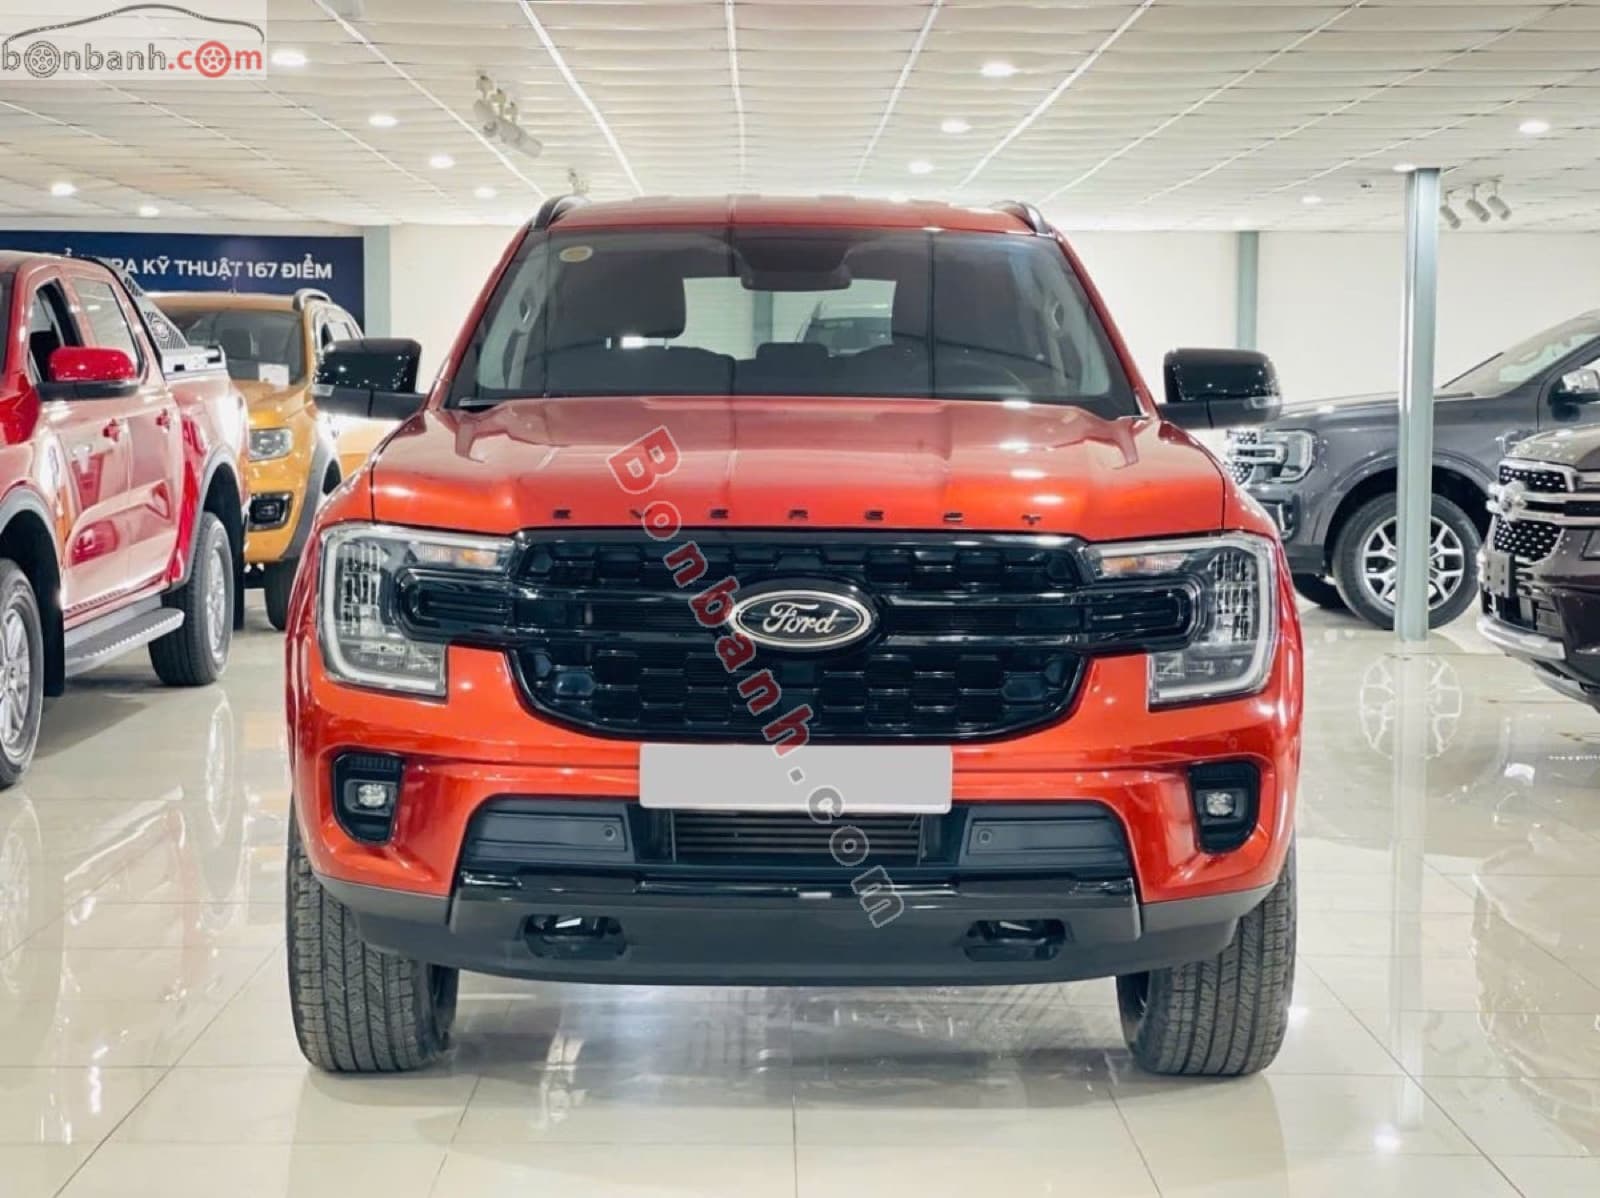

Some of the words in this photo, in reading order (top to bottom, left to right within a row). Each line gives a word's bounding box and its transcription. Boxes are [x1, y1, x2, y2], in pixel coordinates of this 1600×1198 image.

[143, 255, 169, 275] KỸ
[174, 257, 243, 281] THUẬT
[246, 261, 278, 279] 167
[280, 253, 333, 280] ĐIỂM
[762, 601, 840, 633] Ford
